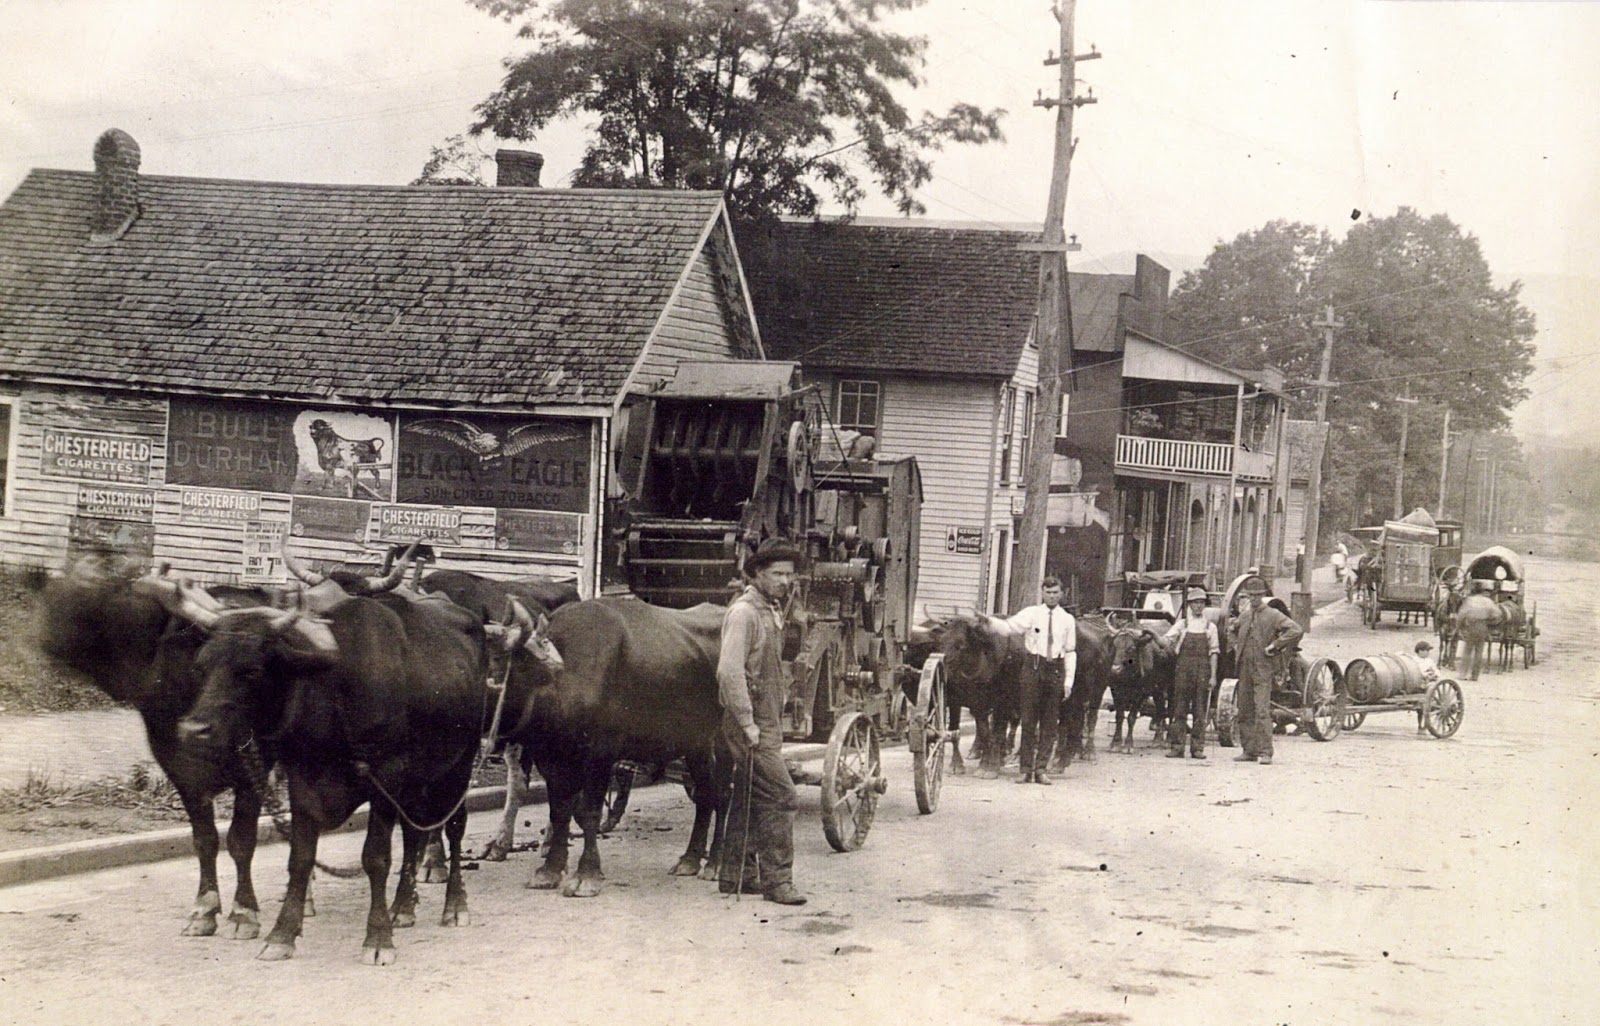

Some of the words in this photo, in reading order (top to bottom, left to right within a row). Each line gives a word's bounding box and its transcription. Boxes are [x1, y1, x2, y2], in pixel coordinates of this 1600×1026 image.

[44, 434, 150, 462] CHESTERFIELD
[56, 457, 134, 473] CIGARETTES
[399, 452, 477, 483] BLACK
[510, 457, 587, 488] EAGLE
[79, 489, 152, 508] CHESTERFIELD
[183, 491, 258, 511] CHESTERFIELD
[499, 490, 561, 505] TOBACCO
[86, 505, 144, 517] CIGARETTES
[191, 508, 249, 519] CIGARETTES
[382, 509, 459, 529] CHESTERFIELD
[391, 525, 450, 538] CIGARETTES
